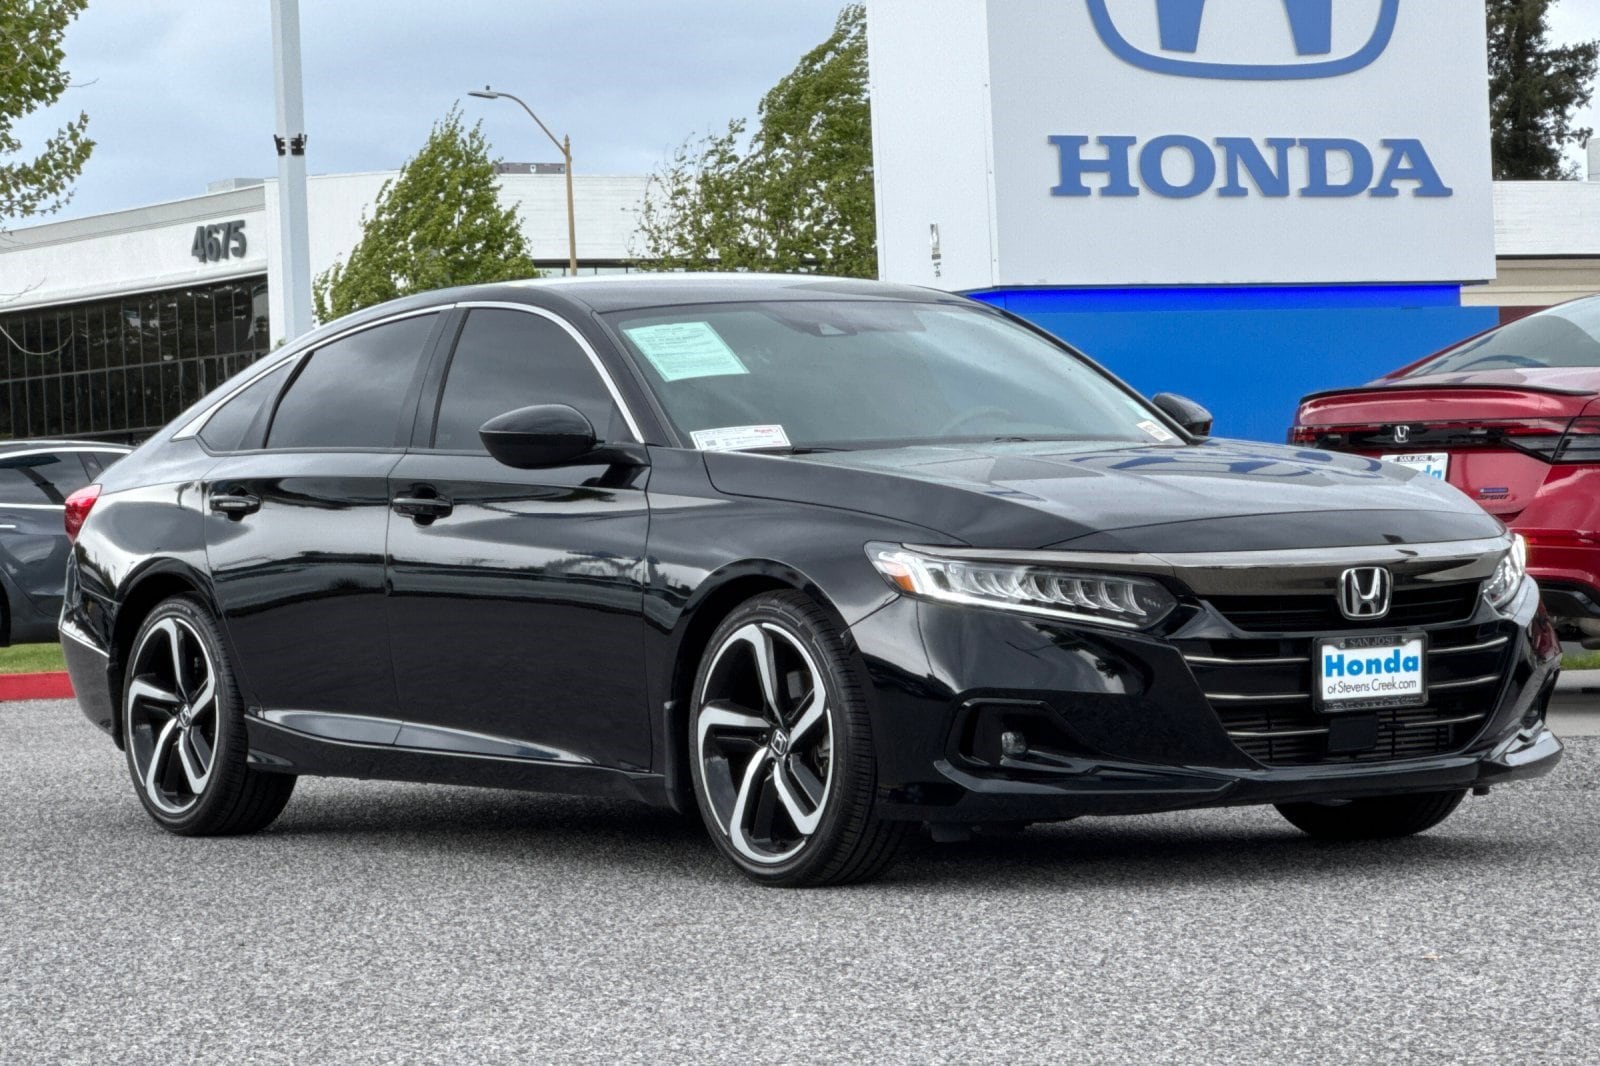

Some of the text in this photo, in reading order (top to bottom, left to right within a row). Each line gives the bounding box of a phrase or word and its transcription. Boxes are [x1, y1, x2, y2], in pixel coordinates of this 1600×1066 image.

[1048, 135, 1453, 198] HONDA
[191, 220, 247, 263] 4675
[1350, 638, 1370, 647] SAN
[1325, 649, 1419, 677] Honda
[1328, 676, 1417, 694] of Stevens Creek.com
